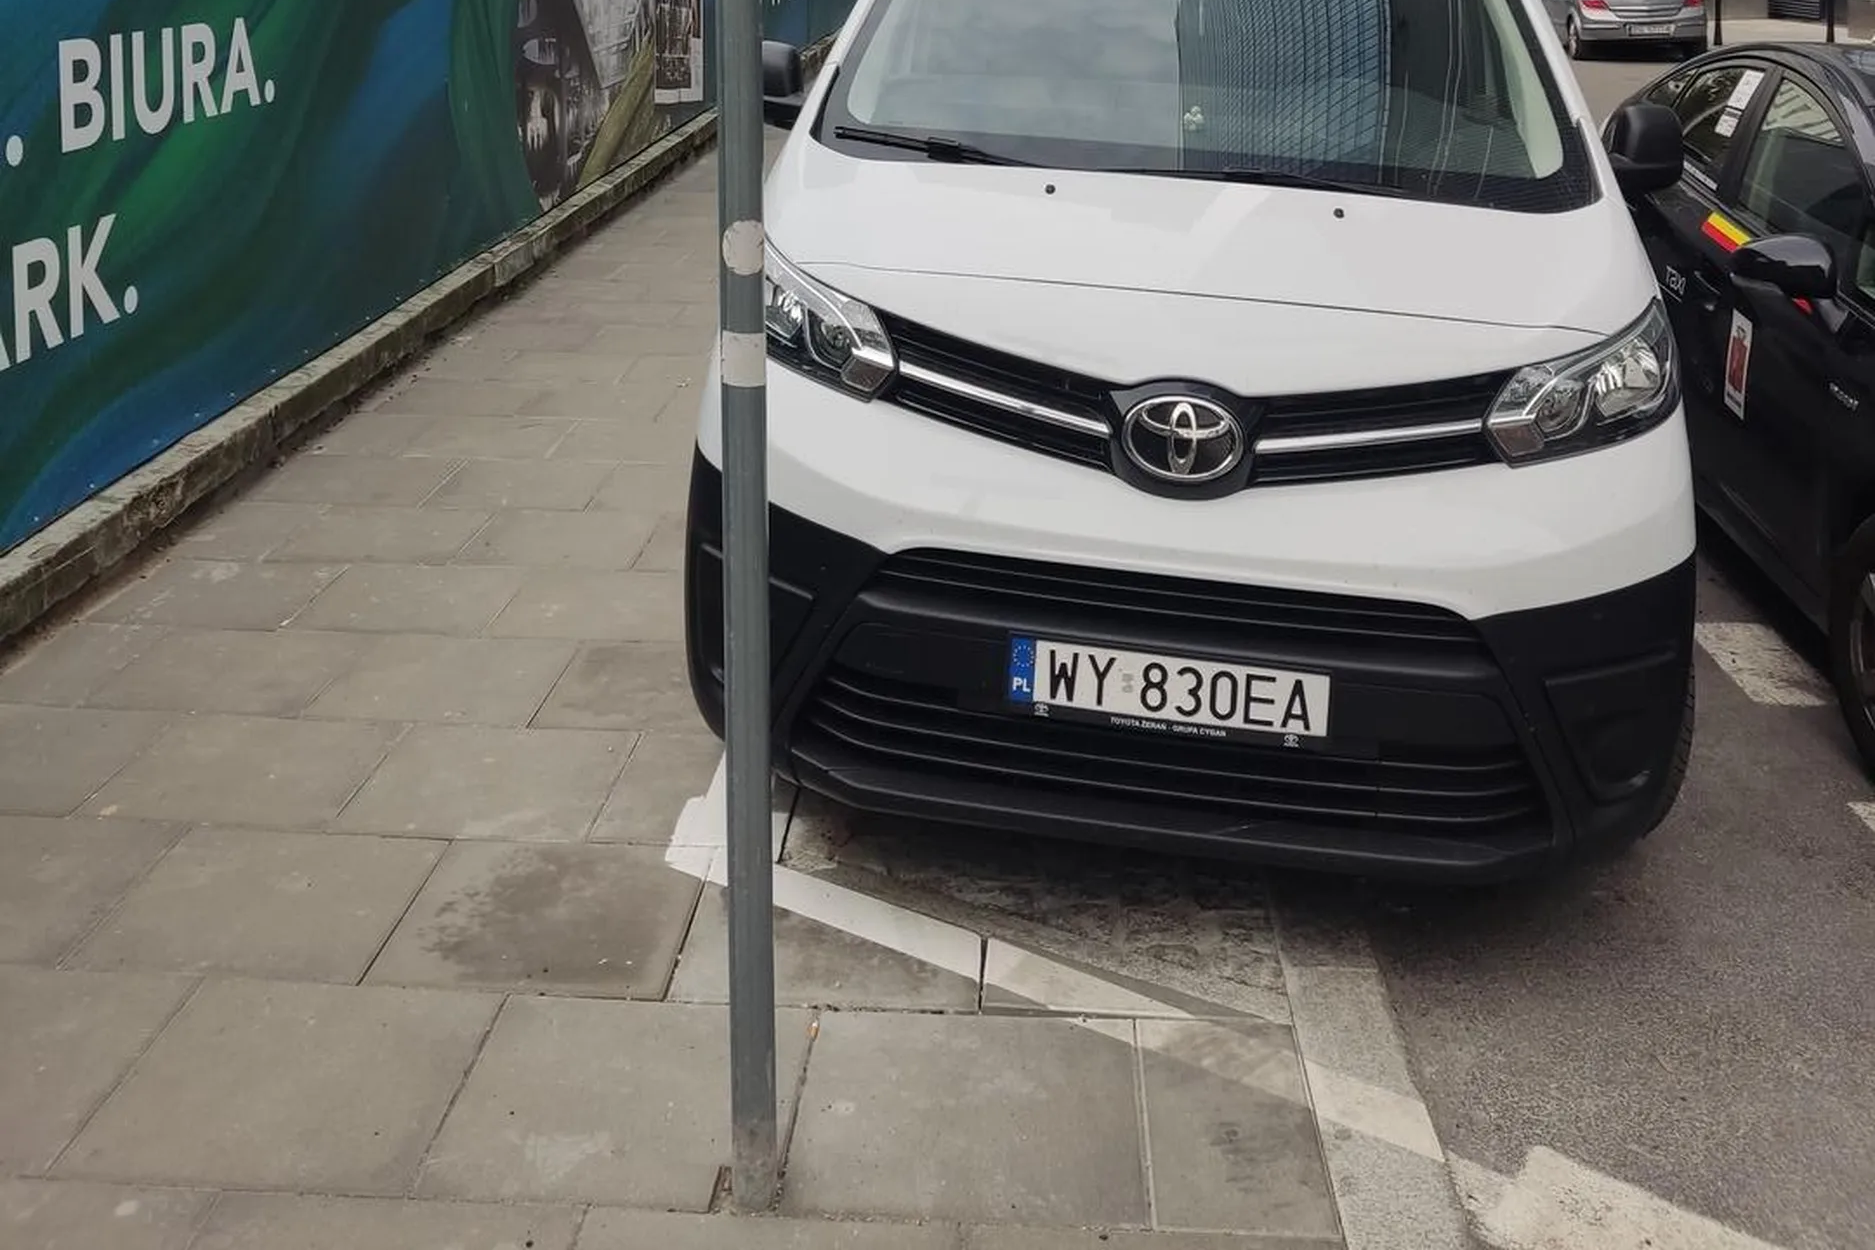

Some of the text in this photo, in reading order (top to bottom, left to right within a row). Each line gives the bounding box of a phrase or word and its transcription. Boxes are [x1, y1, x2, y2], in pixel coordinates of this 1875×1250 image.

[58, 17, 275, 153] BIURA.
[1012, 676, 1031, 693] PL
[1049, 649, 1311, 732] WY 830EA
[1110, 716, 1140, 728] TOYOTA
[1173, 724, 1199, 736] GRUPA
